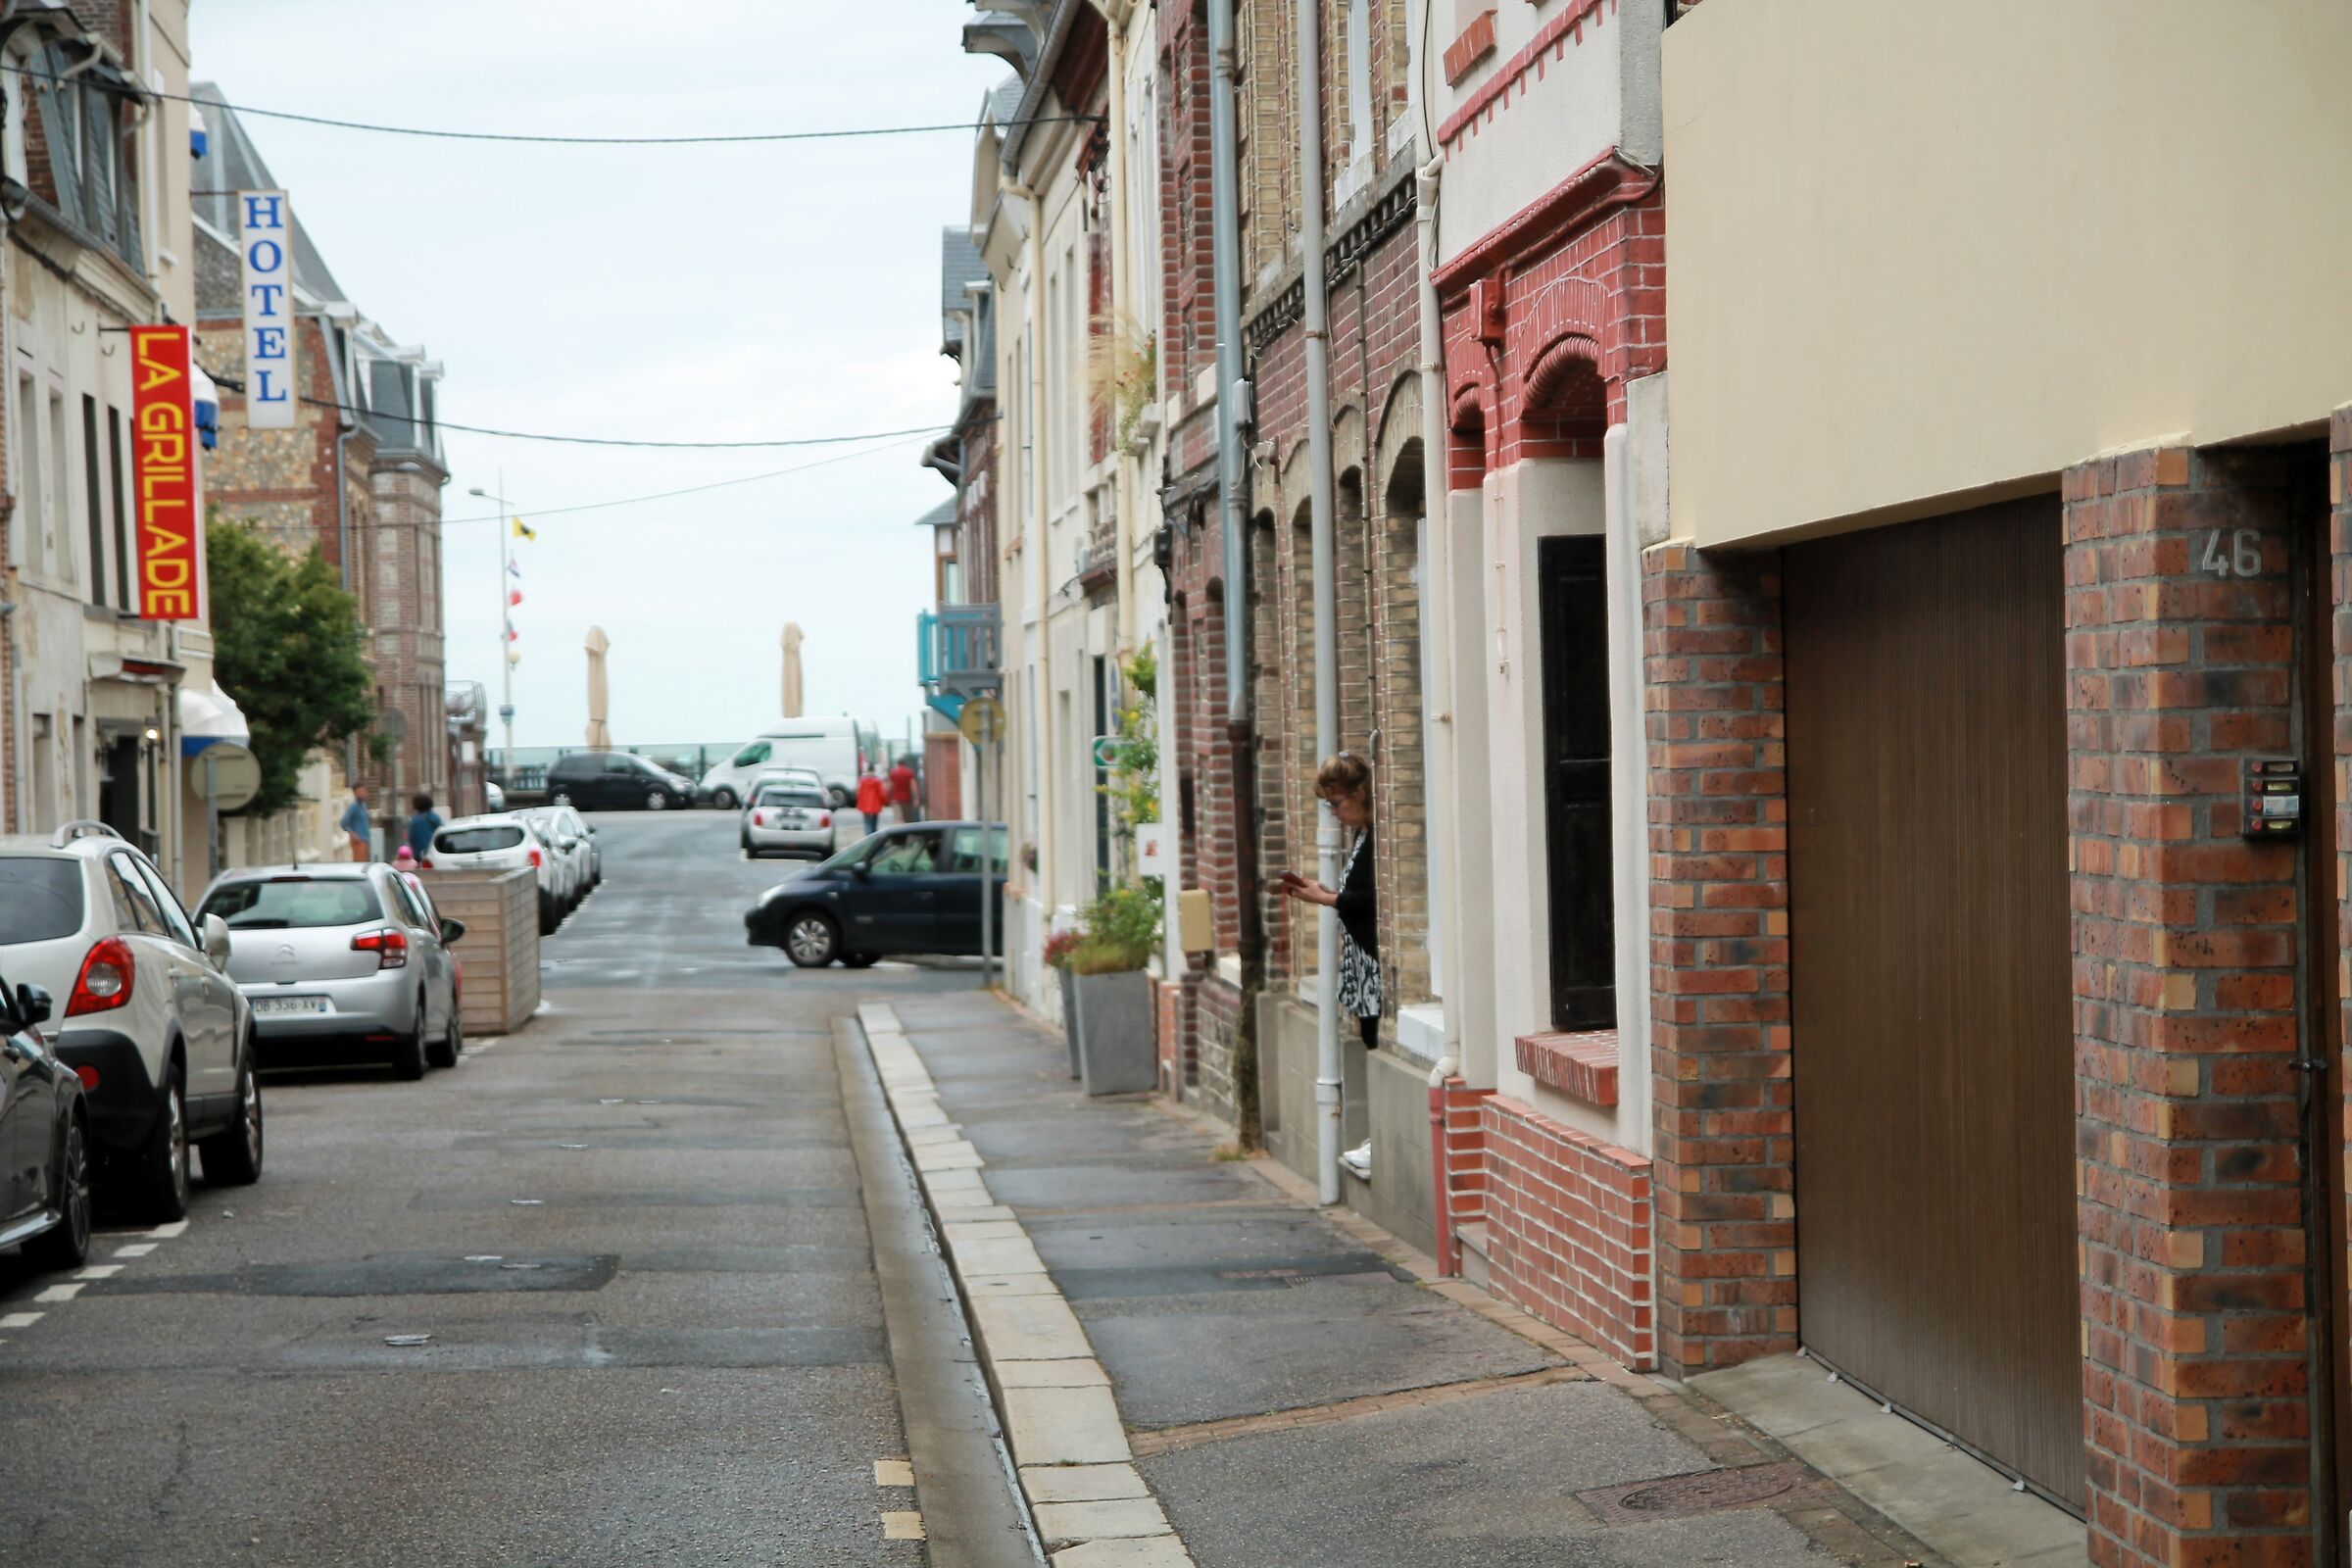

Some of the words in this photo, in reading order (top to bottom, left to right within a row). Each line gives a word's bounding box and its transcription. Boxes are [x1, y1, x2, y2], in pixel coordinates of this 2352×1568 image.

[138, 332, 181, 390] LA
[243, 196, 286, 403] HOTEL
[140, 401, 190, 615] GRILLADE
[2202, 528, 2262, 578] 46
